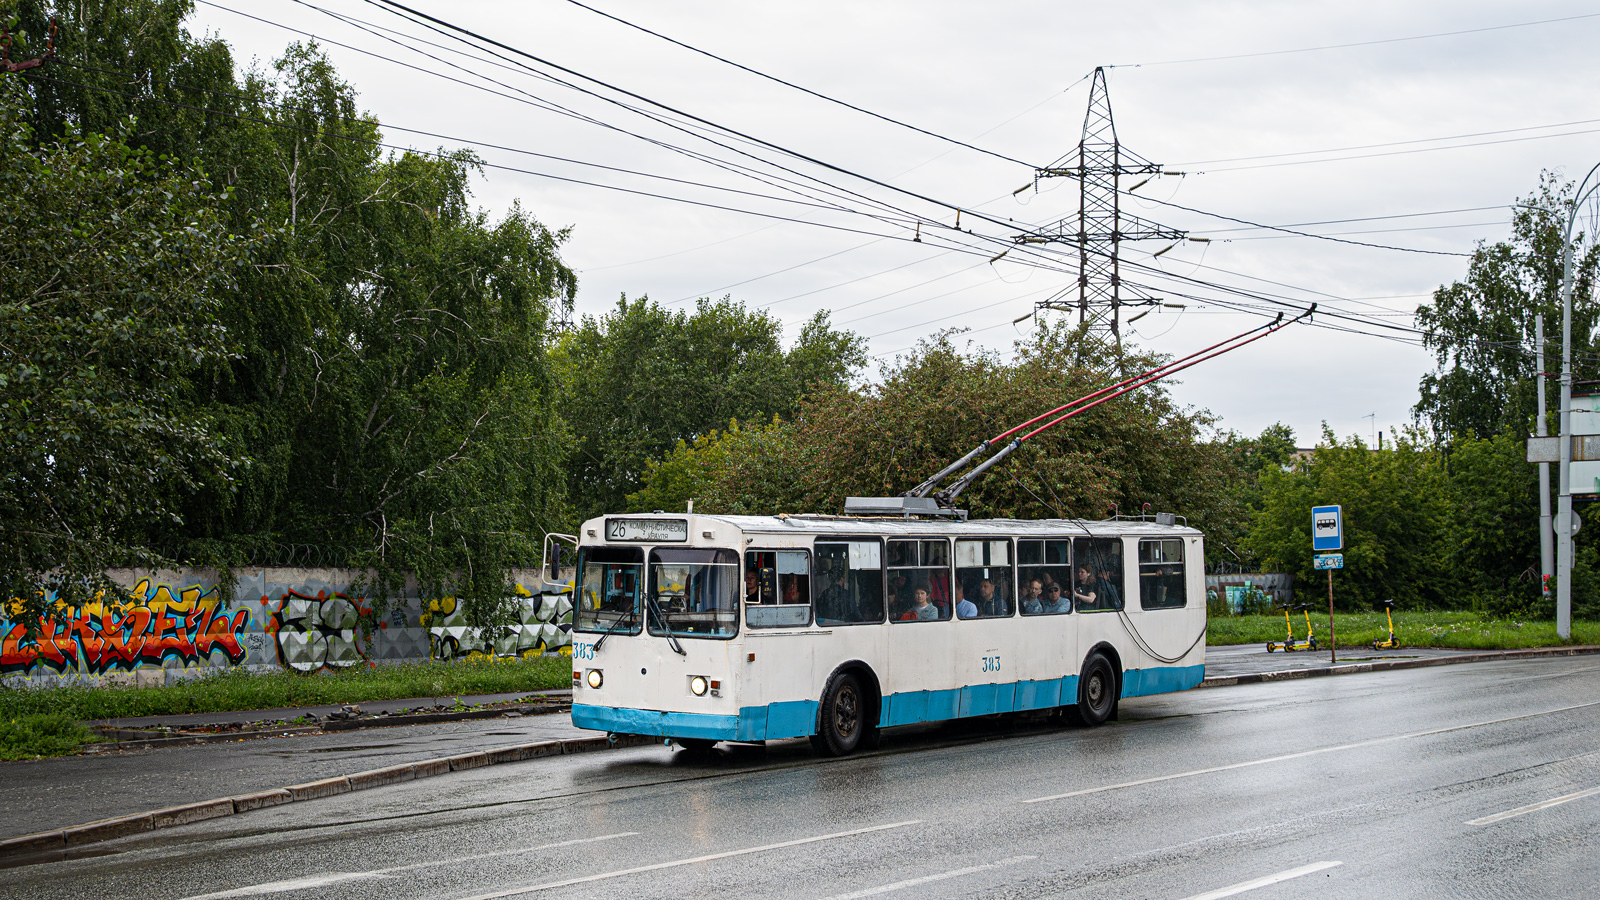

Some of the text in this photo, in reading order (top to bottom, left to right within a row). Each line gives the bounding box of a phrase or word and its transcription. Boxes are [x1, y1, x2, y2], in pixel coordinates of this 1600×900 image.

[611, 520, 626, 538] 26
[572, 642, 594, 661] 383
[982, 655, 1001, 673] 383
